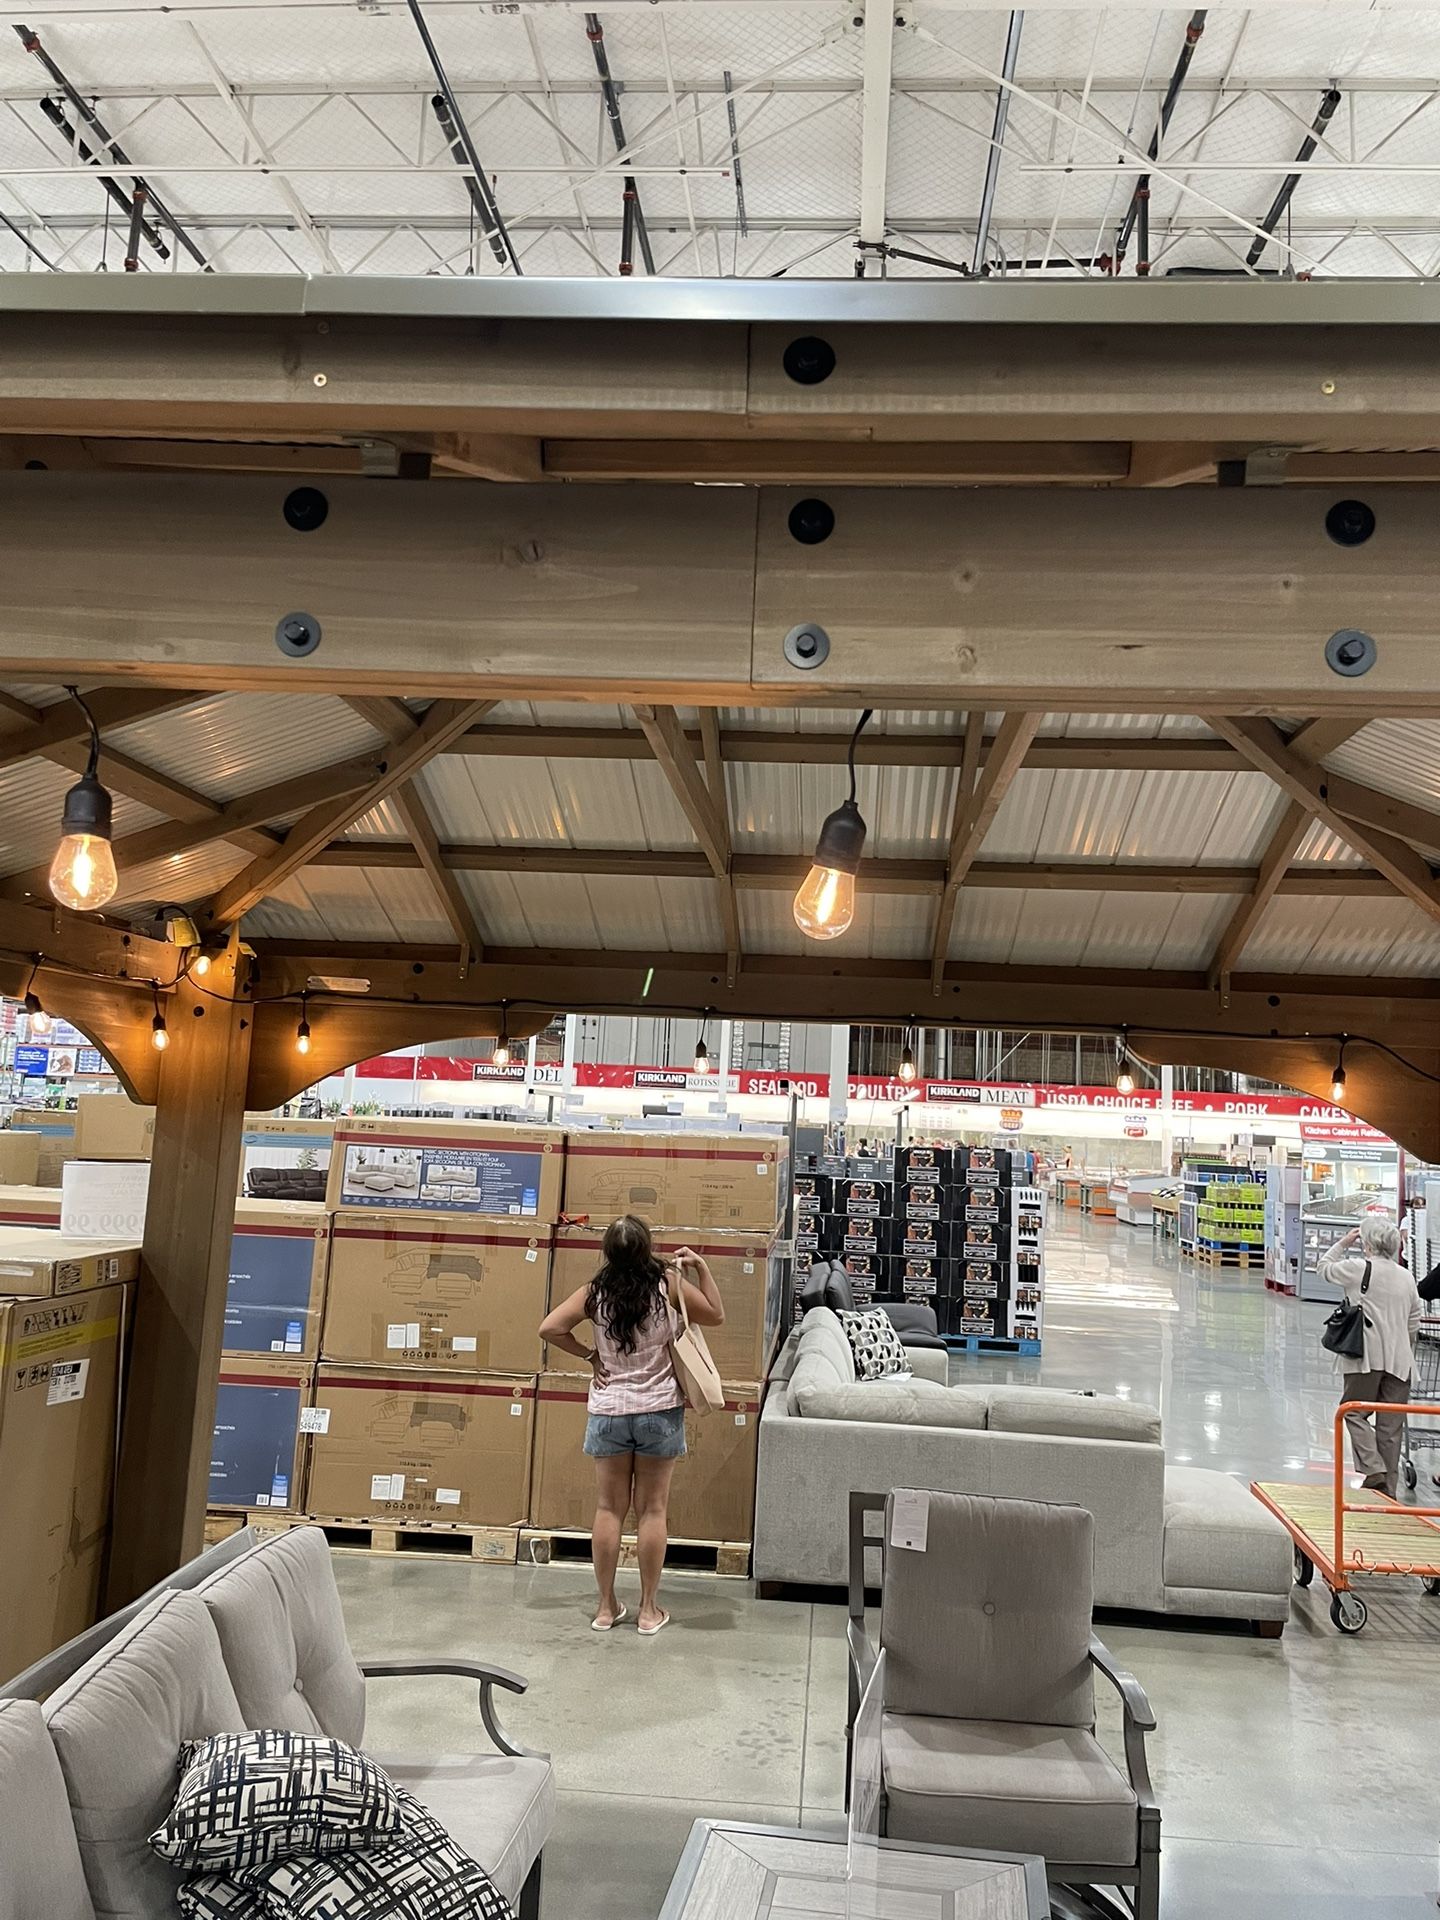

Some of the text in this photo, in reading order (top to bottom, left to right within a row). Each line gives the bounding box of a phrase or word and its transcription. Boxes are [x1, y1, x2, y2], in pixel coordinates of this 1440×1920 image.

[476, 1065, 524, 1077] KIRKLAND
[533, 1068, 563, 1082] DEL
[637, 1072, 686, 1084] KIRKLAND
[687, 1077, 736, 1089] ROTISSIE
[930, 1086, 980, 1098] KIRKLAND
[985, 1089, 1028, 1104] MEAT
[1046, 1092, 1268, 1115] USDA CHOICE BEF PORK
[1304, 1126, 1331, 1135] Kitchen
[1331, 1126, 1359, 1136] Cabinet
